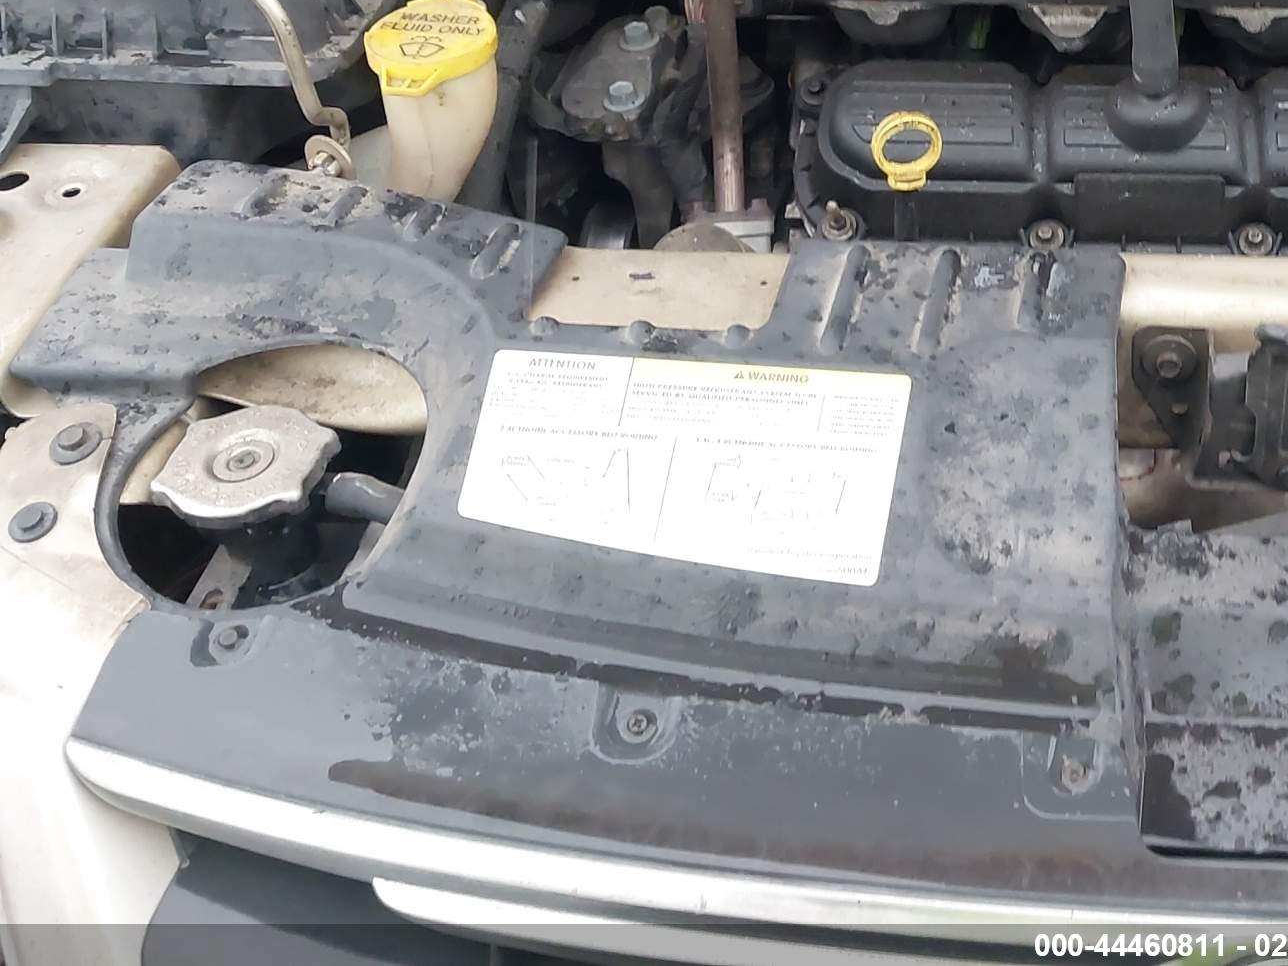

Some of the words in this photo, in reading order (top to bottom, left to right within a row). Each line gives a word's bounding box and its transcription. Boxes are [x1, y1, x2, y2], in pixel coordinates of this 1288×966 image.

[401, 12, 480, 25] WASHER
[380, 21, 433, 32] FLUID
[438, 25, 486, 35] ONLY
[528, 357, 597, 370] ATTENTION
[748, 370, 809, 384] WARNING
